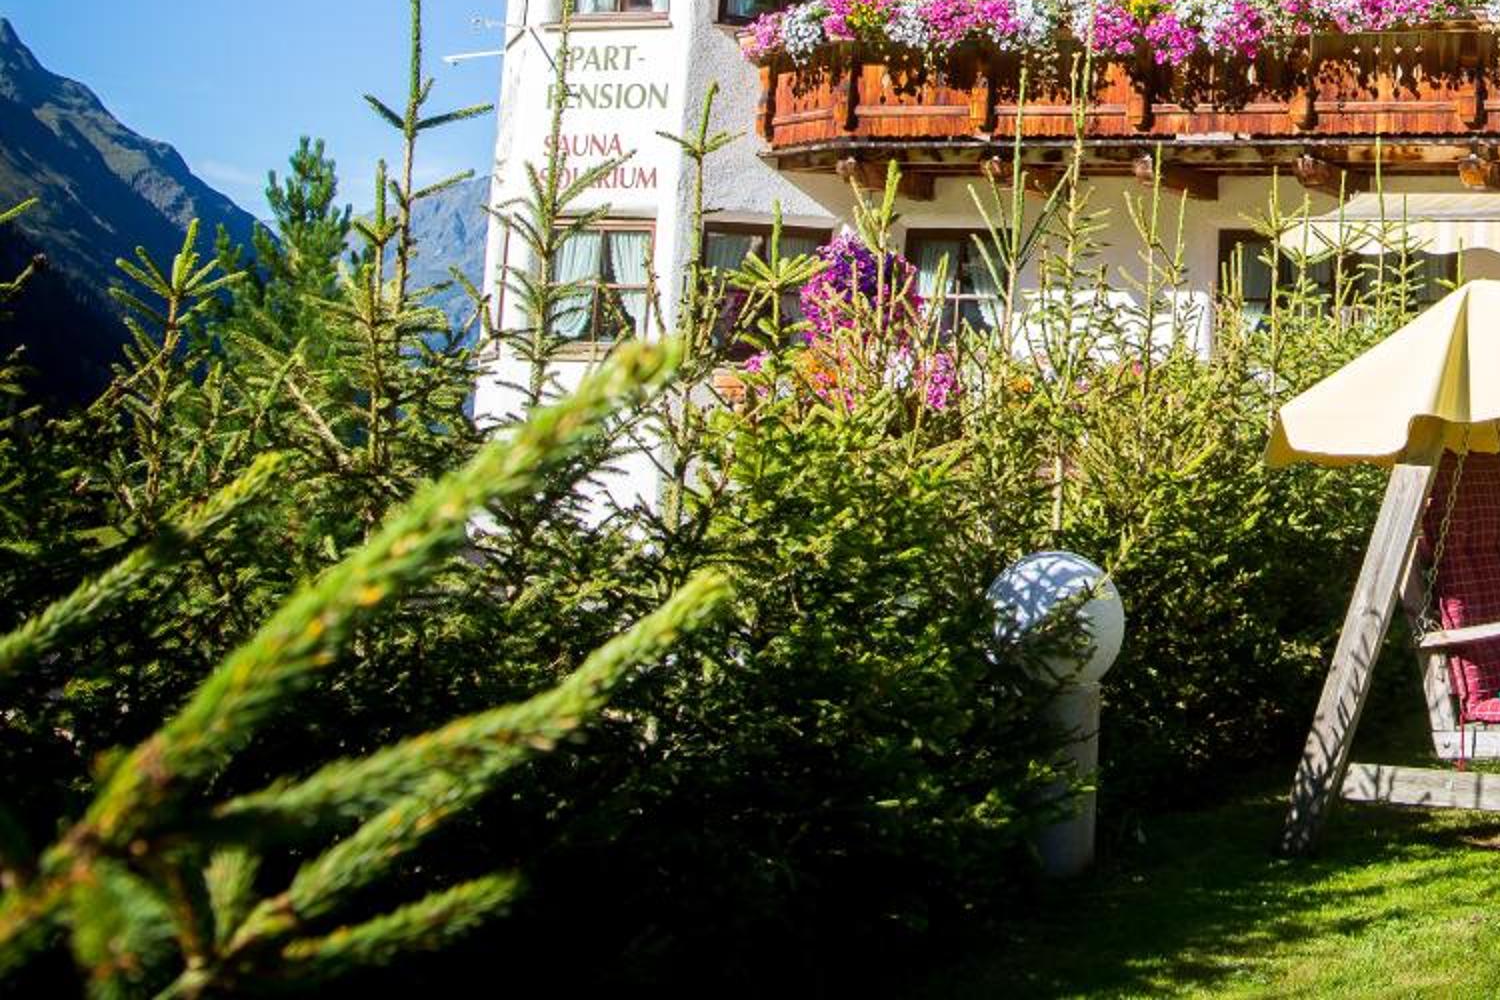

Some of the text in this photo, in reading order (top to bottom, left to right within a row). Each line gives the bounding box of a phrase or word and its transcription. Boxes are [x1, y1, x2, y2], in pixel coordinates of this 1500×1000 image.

[547, 45, 646, 72] PART-
[543, 132, 623, 157] SAUNA
[539, 166, 657, 189] SORIUM
